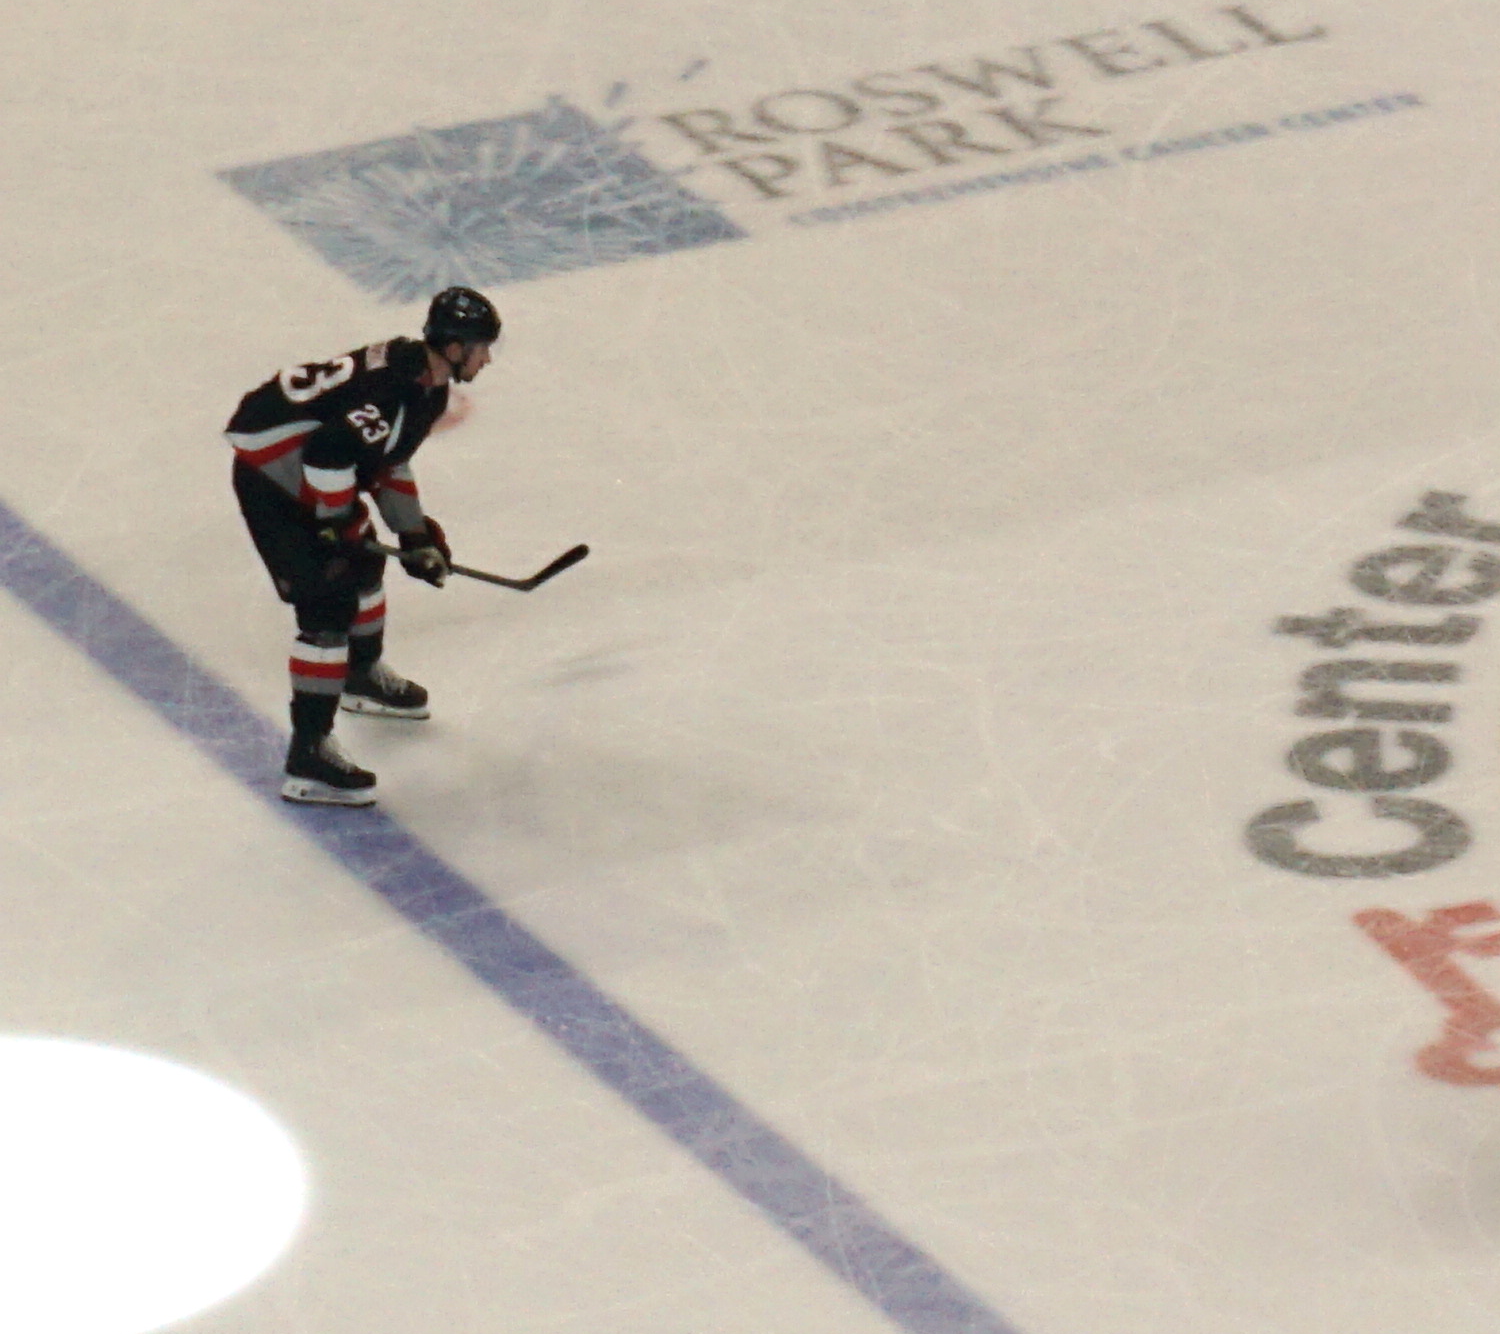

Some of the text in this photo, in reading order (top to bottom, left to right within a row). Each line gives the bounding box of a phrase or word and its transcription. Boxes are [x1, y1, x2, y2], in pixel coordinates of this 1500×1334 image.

[661, 2, 1329, 156] ROSWELL
[723, 94, 1112, 201] PARK
[279, 354, 355, 403] 3
[347, 402, 391, 444] 23
